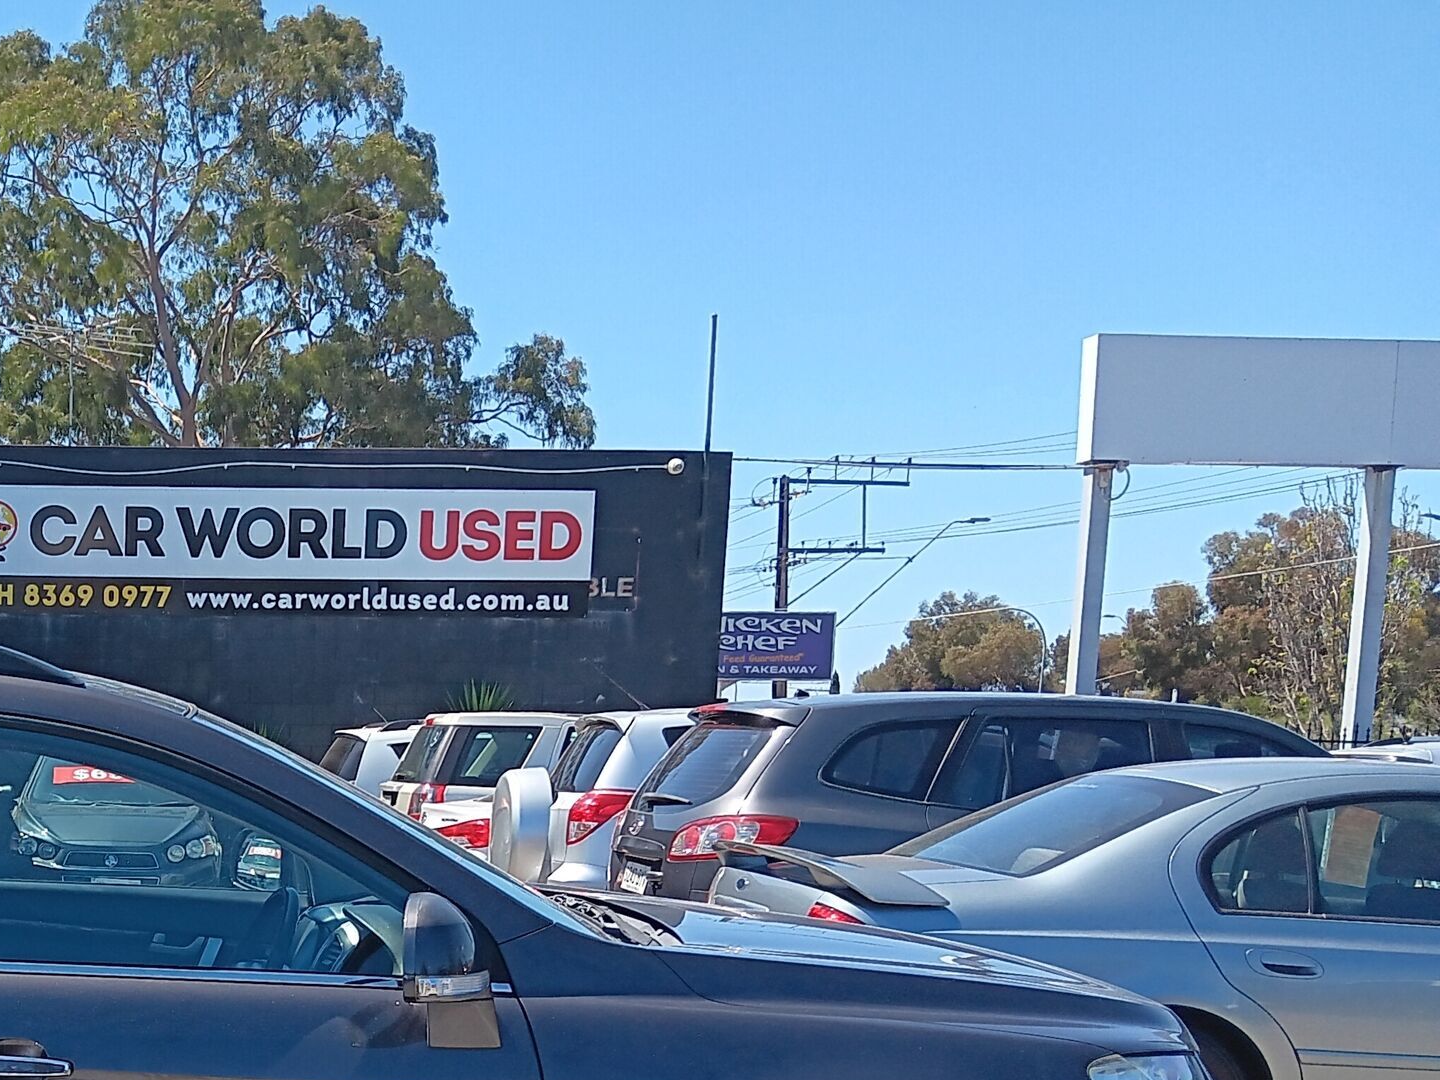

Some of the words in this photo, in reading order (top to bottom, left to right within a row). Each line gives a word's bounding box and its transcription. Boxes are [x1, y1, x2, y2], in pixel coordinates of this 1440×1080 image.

[29, 505, 166, 557] CAR
[176, 506, 408, 560] WORLD
[418, 508, 583, 561] USED
[23, 584, 94, 607] 8369
[103, 585, 173, 608] 0977
[186, 586, 570, 612] www.carworldused.com.au
[730, 665, 740, 674] &
[744, 665, 818, 674] TAKEAWAY
